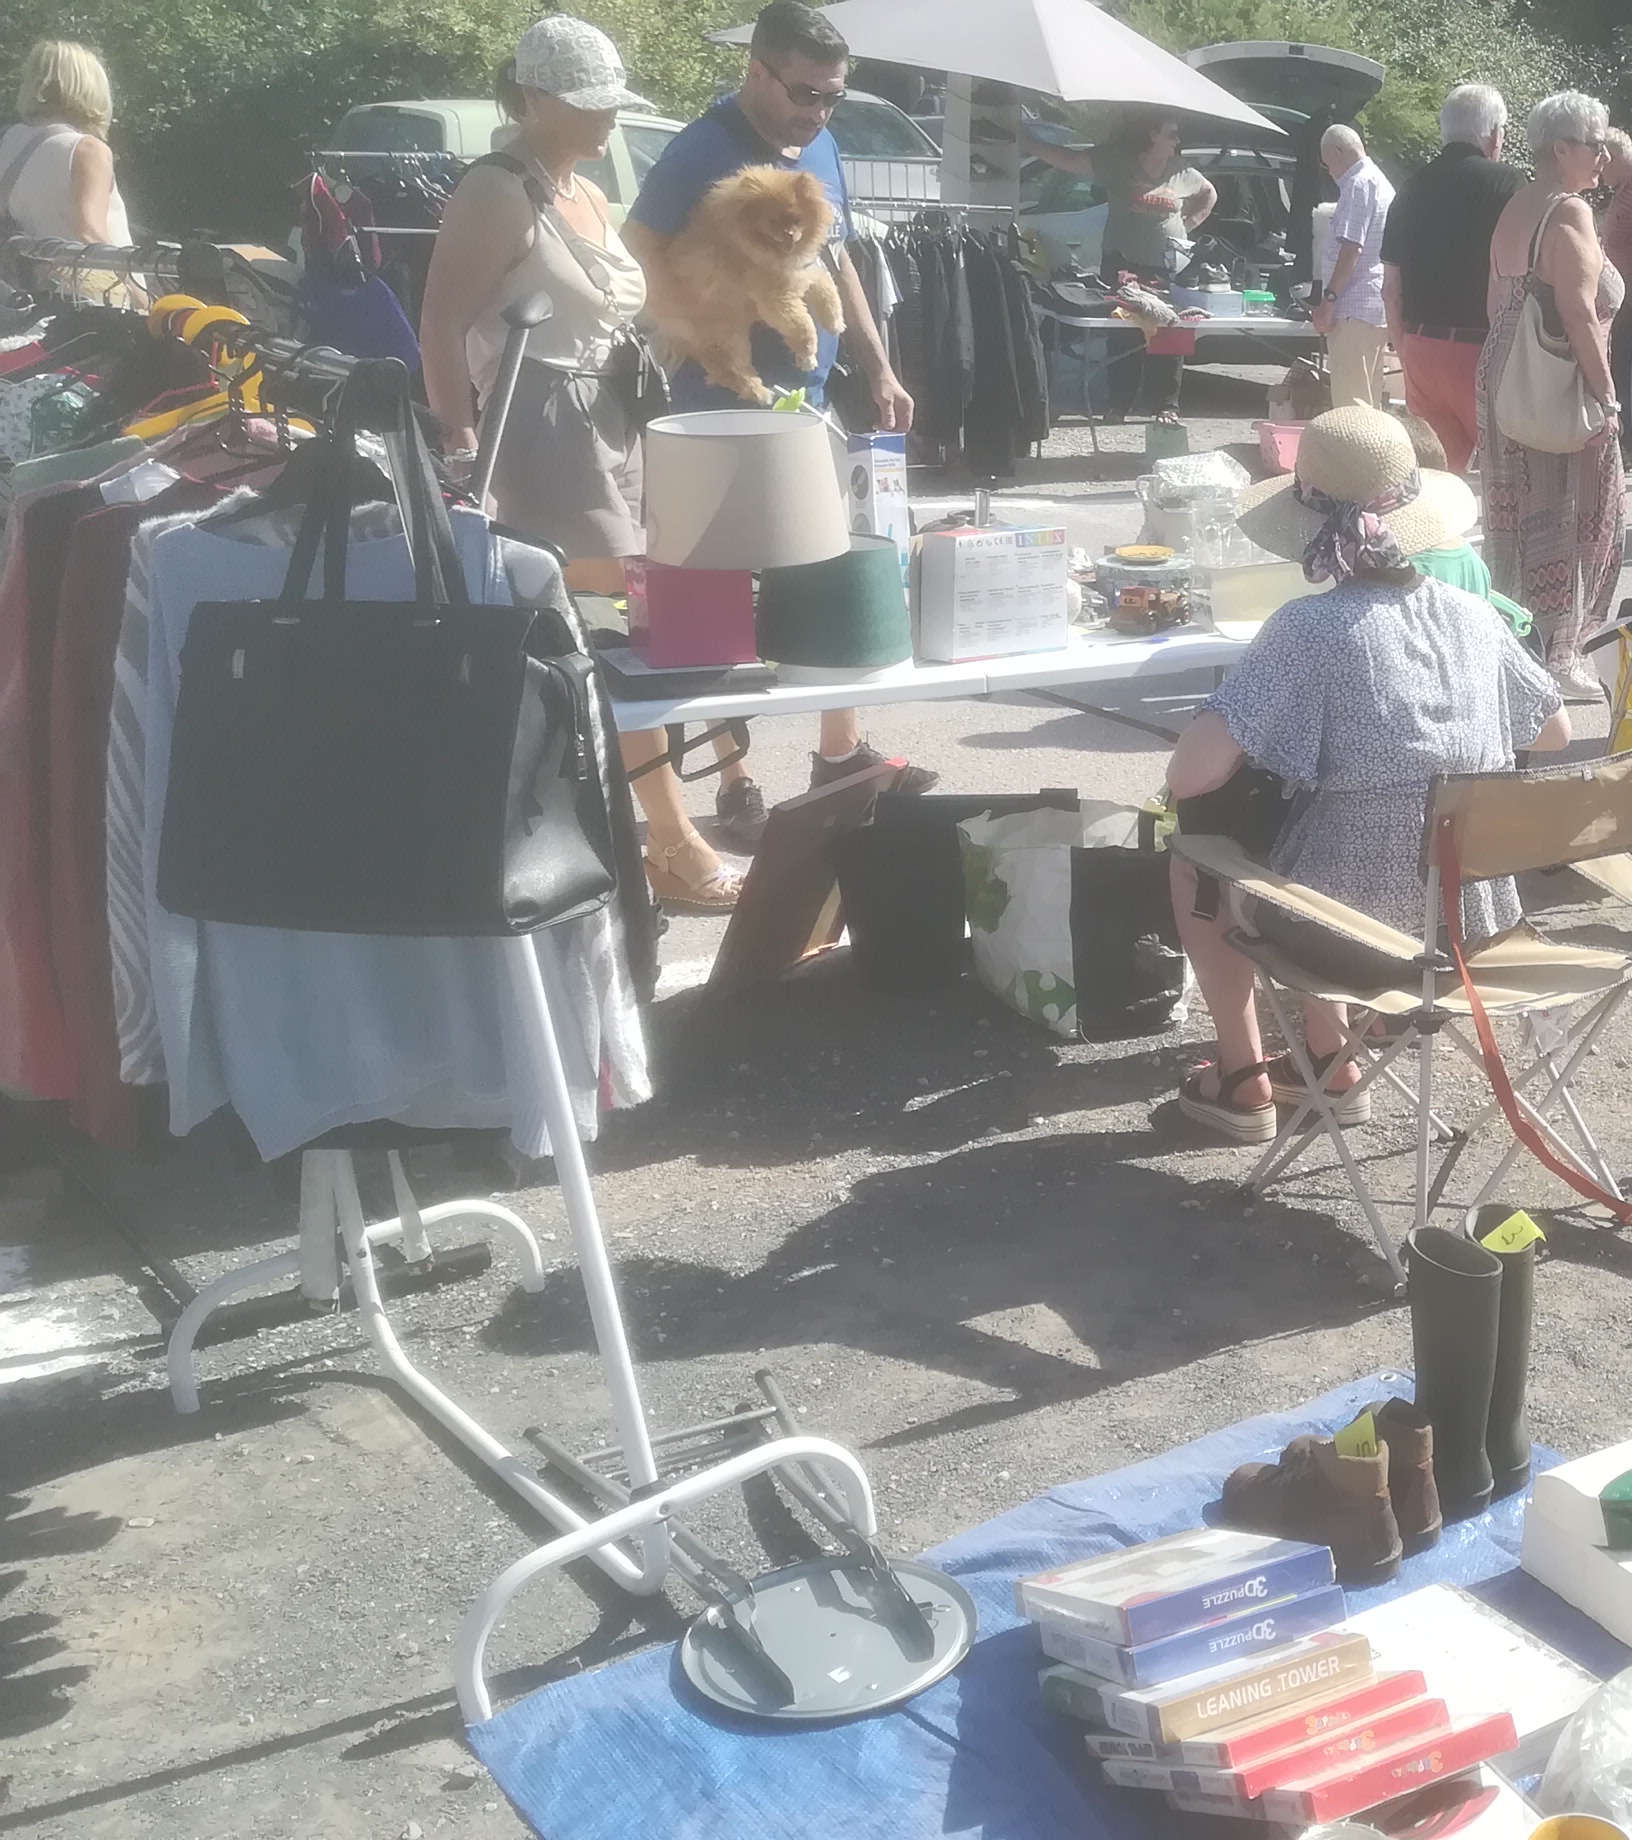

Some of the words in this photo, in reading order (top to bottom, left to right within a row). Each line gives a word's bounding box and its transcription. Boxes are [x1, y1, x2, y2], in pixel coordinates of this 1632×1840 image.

[1018, 530, 1063, 547] INTEX
[1196, 1678, 1273, 1719] LEANING
[1280, 1655, 1341, 1690] TOWER
